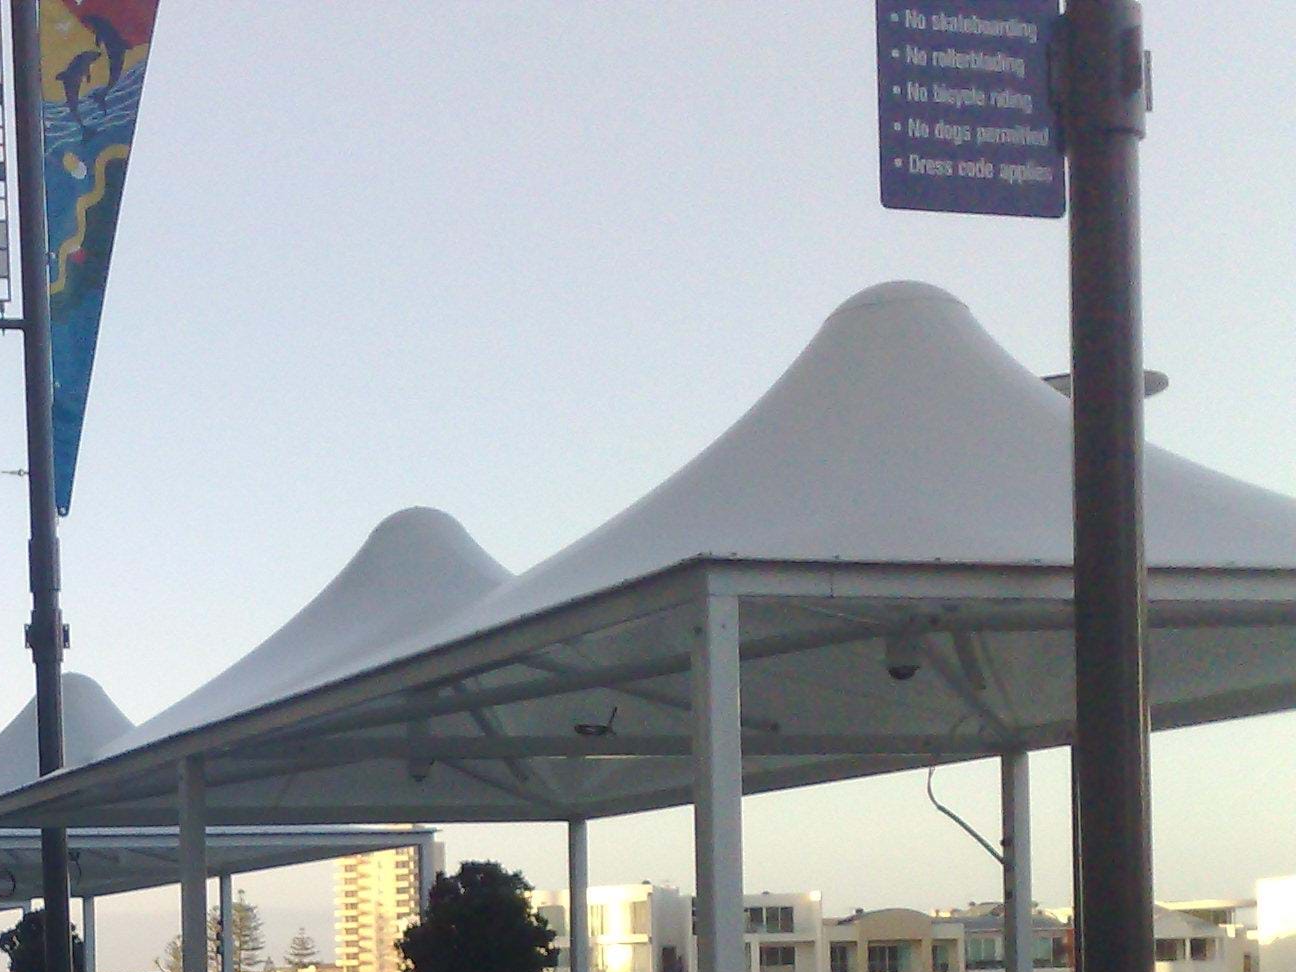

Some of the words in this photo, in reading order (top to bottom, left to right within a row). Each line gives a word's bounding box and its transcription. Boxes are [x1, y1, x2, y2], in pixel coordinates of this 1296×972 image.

[905, 10, 925, 30] No
[932, 13, 1038, 43] skateboarding
[907, 45, 927, 66] No
[932, 48, 1025, 78] rollerblading
[908, 81, 927, 102] No
[908, 118, 929, 138] No
[934, 120, 971, 145] dogs
[976, 125, 1049, 146] permitted
[909, 153, 953, 176] Dress
[958, 157, 994, 178] code
[1000, 162, 1053, 184] applies
